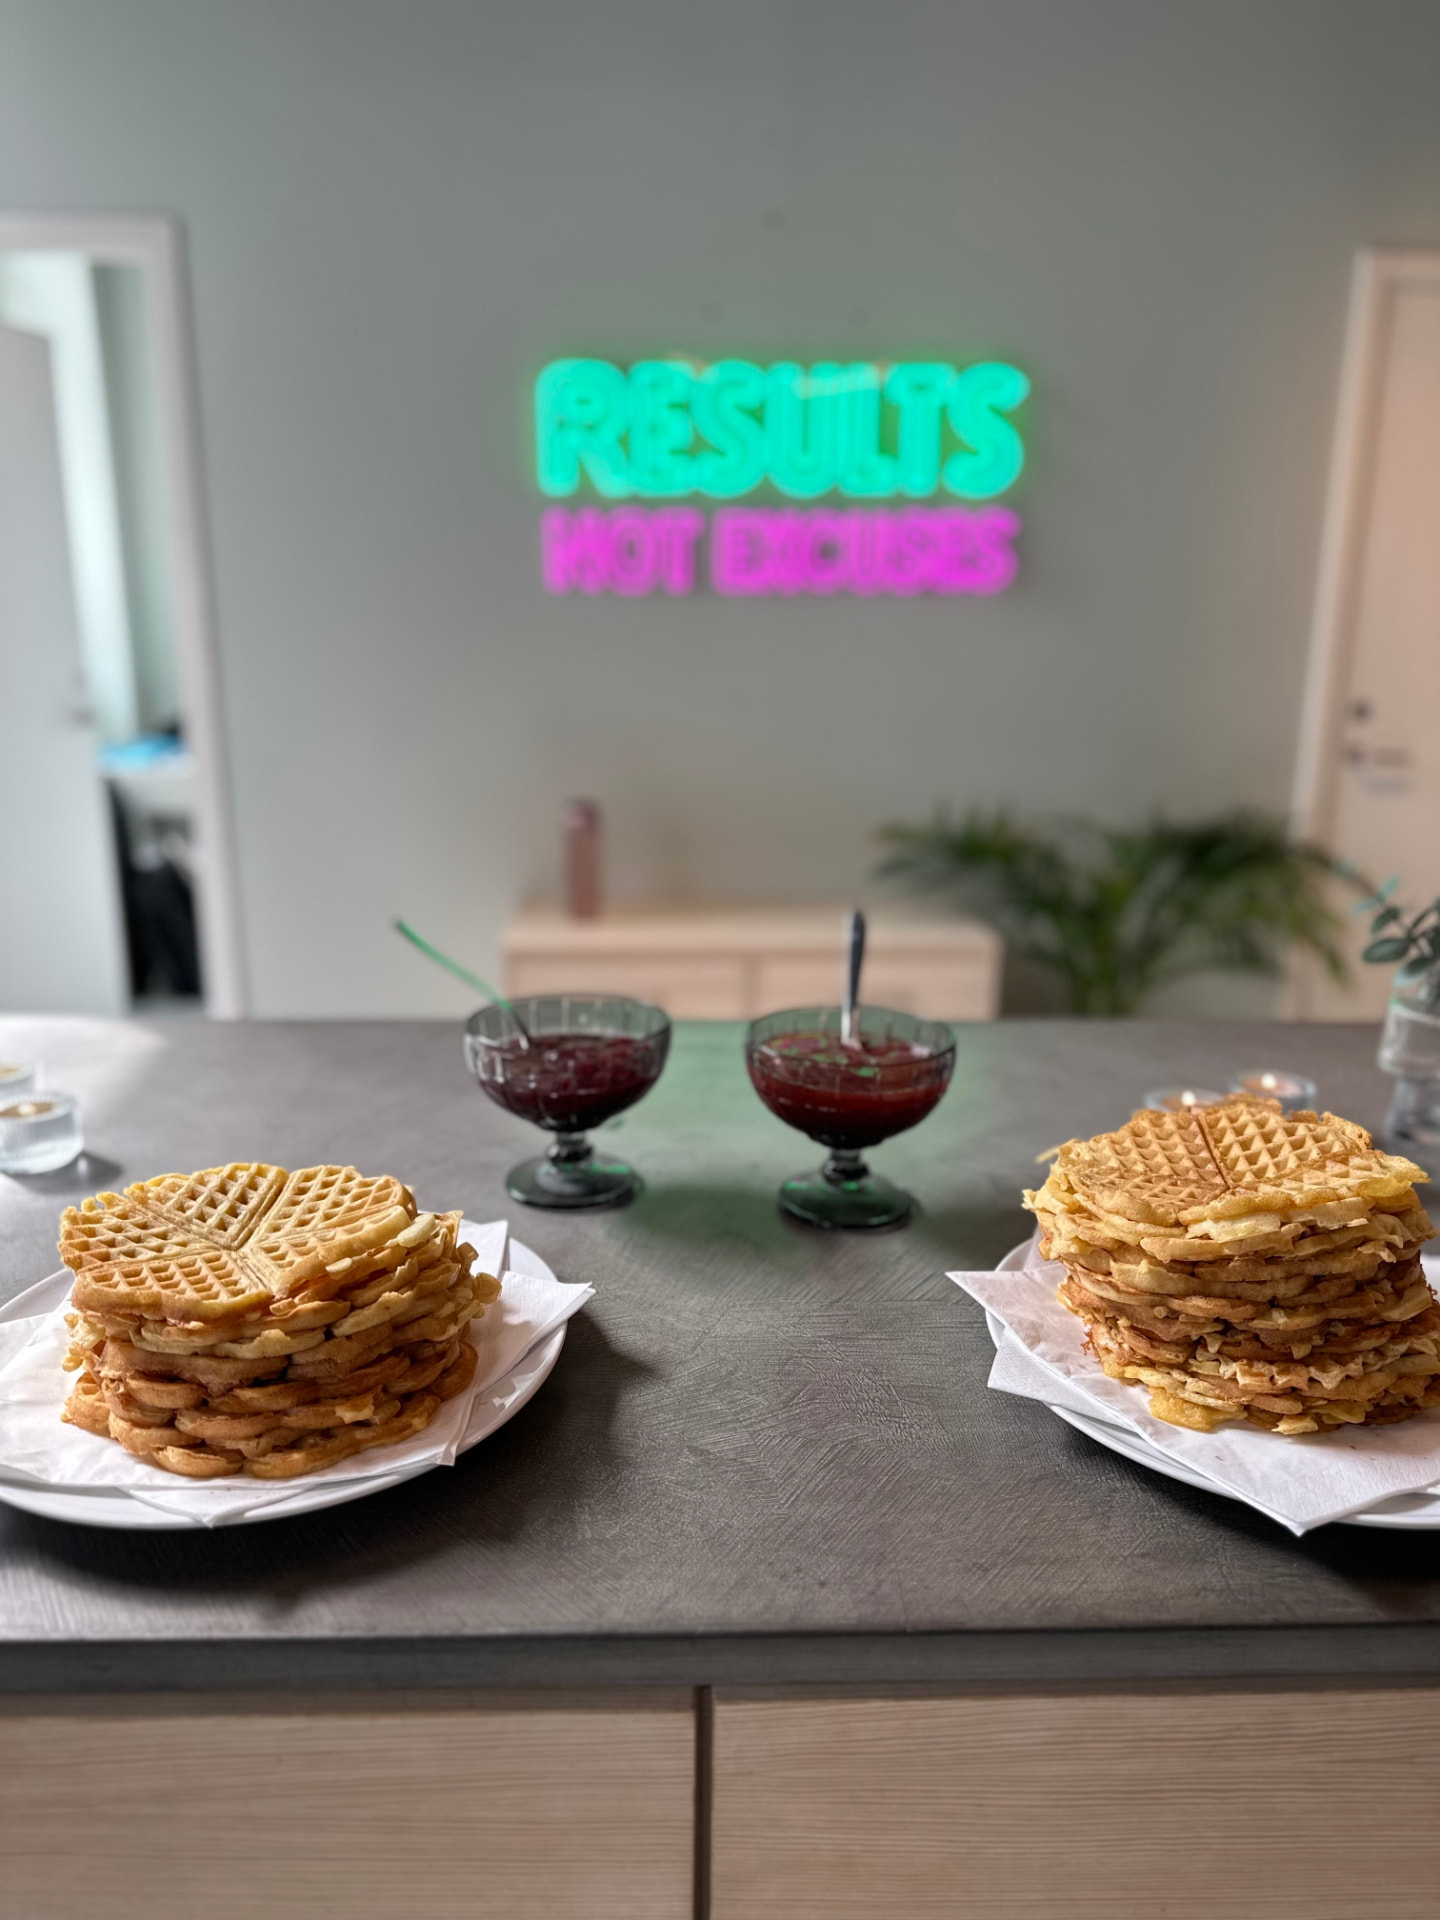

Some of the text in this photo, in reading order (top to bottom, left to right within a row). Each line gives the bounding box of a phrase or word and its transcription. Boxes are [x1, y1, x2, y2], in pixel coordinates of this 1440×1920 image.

[534, 358, 1030, 499] RESULTS
[541, 505, 1021, 597] NOT EXCUSES
